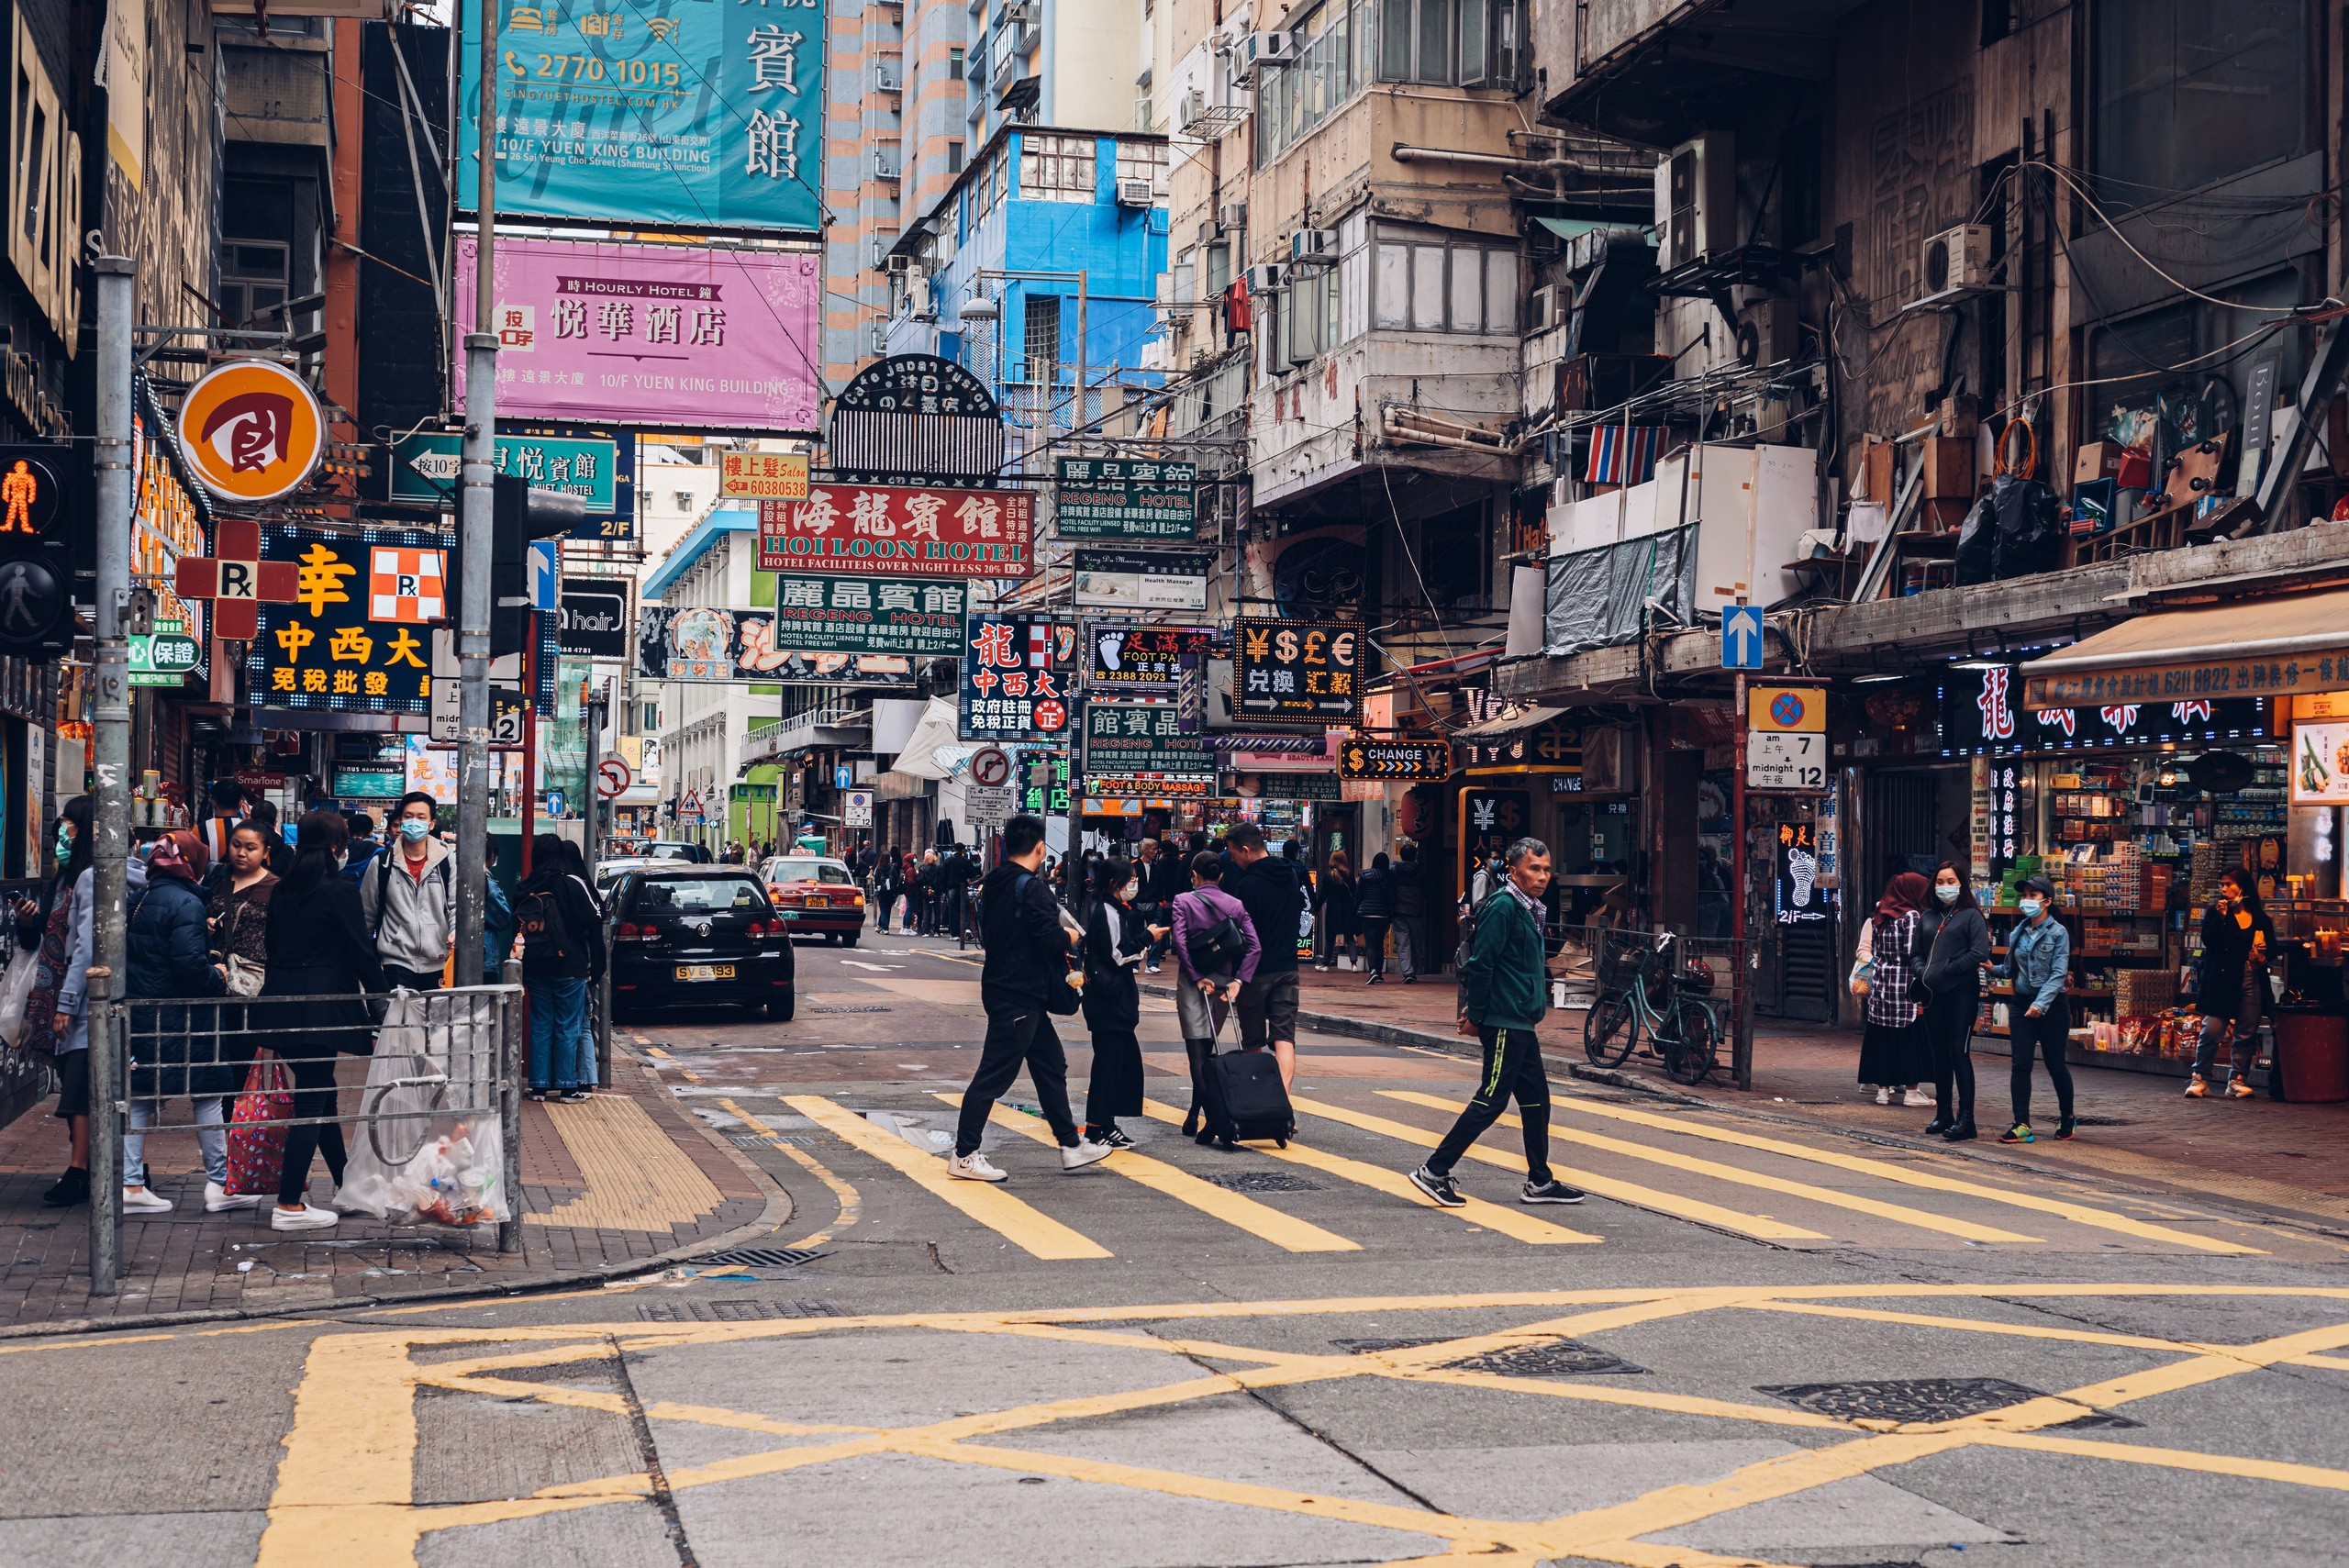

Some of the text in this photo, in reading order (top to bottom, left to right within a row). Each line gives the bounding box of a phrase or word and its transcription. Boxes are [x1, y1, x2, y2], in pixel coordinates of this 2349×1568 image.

[546, 8, 558, 36] 套房
[612, 13, 624, 41] 寄存
[537, 52, 680, 86] 2770 1015
[505, 88, 679, 110] SINGYUETHOSTEL.COM.HK
[745, 24, 804, 179] 賓館
[514, 117, 585, 139] 遠景大廈
[501, 138, 710, 163] 10/F YUEN KING BUILDING
[510, 151, 521, 161] 26
[523, 152, 538, 162] Sai
[540, 153, 566, 165] Yeung
[568, 154, 587, 165] Choi
[588, 156, 616, 167] Street
[618, 158, 661, 172] (Shantung
[674, 161, 711, 173] junction)
[567, 279, 581, 294] 時
[698, 285, 712, 300] 鐘
[505, 310, 523, 328] 按
[521, 369, 585, 386] 遠景大廈
[599, 373, 629, 389] 10/F
[633, 374, 674, 391] YUEN
[679, 376, 715, 393] KING
[719, 376, 788, 396] BUILDING
[2249, 367, 2270, 448] Bout
[724, 453, 807, 479] 樓上髮 Salon
[561, 484, 595, 496] HOSTEL
[751, 478, 807, 496] 60380538
[1060, 492, 1192, 508] REGENG HOTEL
[792, 487, 1003, 541] 海龍賓館
[600, 520, 630, 537] 2/F
[764, 535, 1029, 562] HOI LOON HOTEL
[763, 557, 1002, 575] HOTEL FACILITEIS OVER NIGHT LESS 20%
[298, 542, 357, 617] 幸
[782, 579, 964, 614] 麗晶賓館
[572, 609, 614, 632] hair
[783, 606, 961, 628] REGENG HOTEL
[780, 619, 962, 639] 持牌賓館 酒店設備 豪華套房 歡迎自由行
[780, 632, 864, 642] HOTEL FACILITY LIENSED
[274, 620, 429, 669] 中西大
[866, 636, 914, 650] 免費wifi上網
[970, 621, 1022, 668] 龍
[1123, 652, 1156, 662] FOOT
[272, 667, 389, 696] 免稅批發
[971, 668, 1069, 698] 中西大
[1109, 671, 1166, 682] 2388 2093
[971, 699, 1032, 713] 政府註冊
[1976, 667, 2015, 741] 龍
[971, 715, 1032, 730] 免稅正貨
[1041, 711, 1059, 728] 正
[1089, 738, 1199, 751] REGENG HOT
[1367, 747, 1422, 762] CHANGE
[1762, 744, 1785, 754] 上午
[1765, 734, 1811, 755] am 7
[338, 764, 360, 773] Venus
[1316, 754, 1335, 762] LAND
[1553, 776, 1582, 792] CHANGE
[1752, 763, 1821, 785] midnight 12
[1762, 774, 1784, 785] 午夜
[1099, 781, 1207, 794] FOOT & BODY MASSAGE
[1816, 831, 1836, 874] 音響
[1816, 875, 1835, 885] 4/F
[1779, 910, 1801, 924] 2/F
[678, 965, 733, 978] SV 6393
